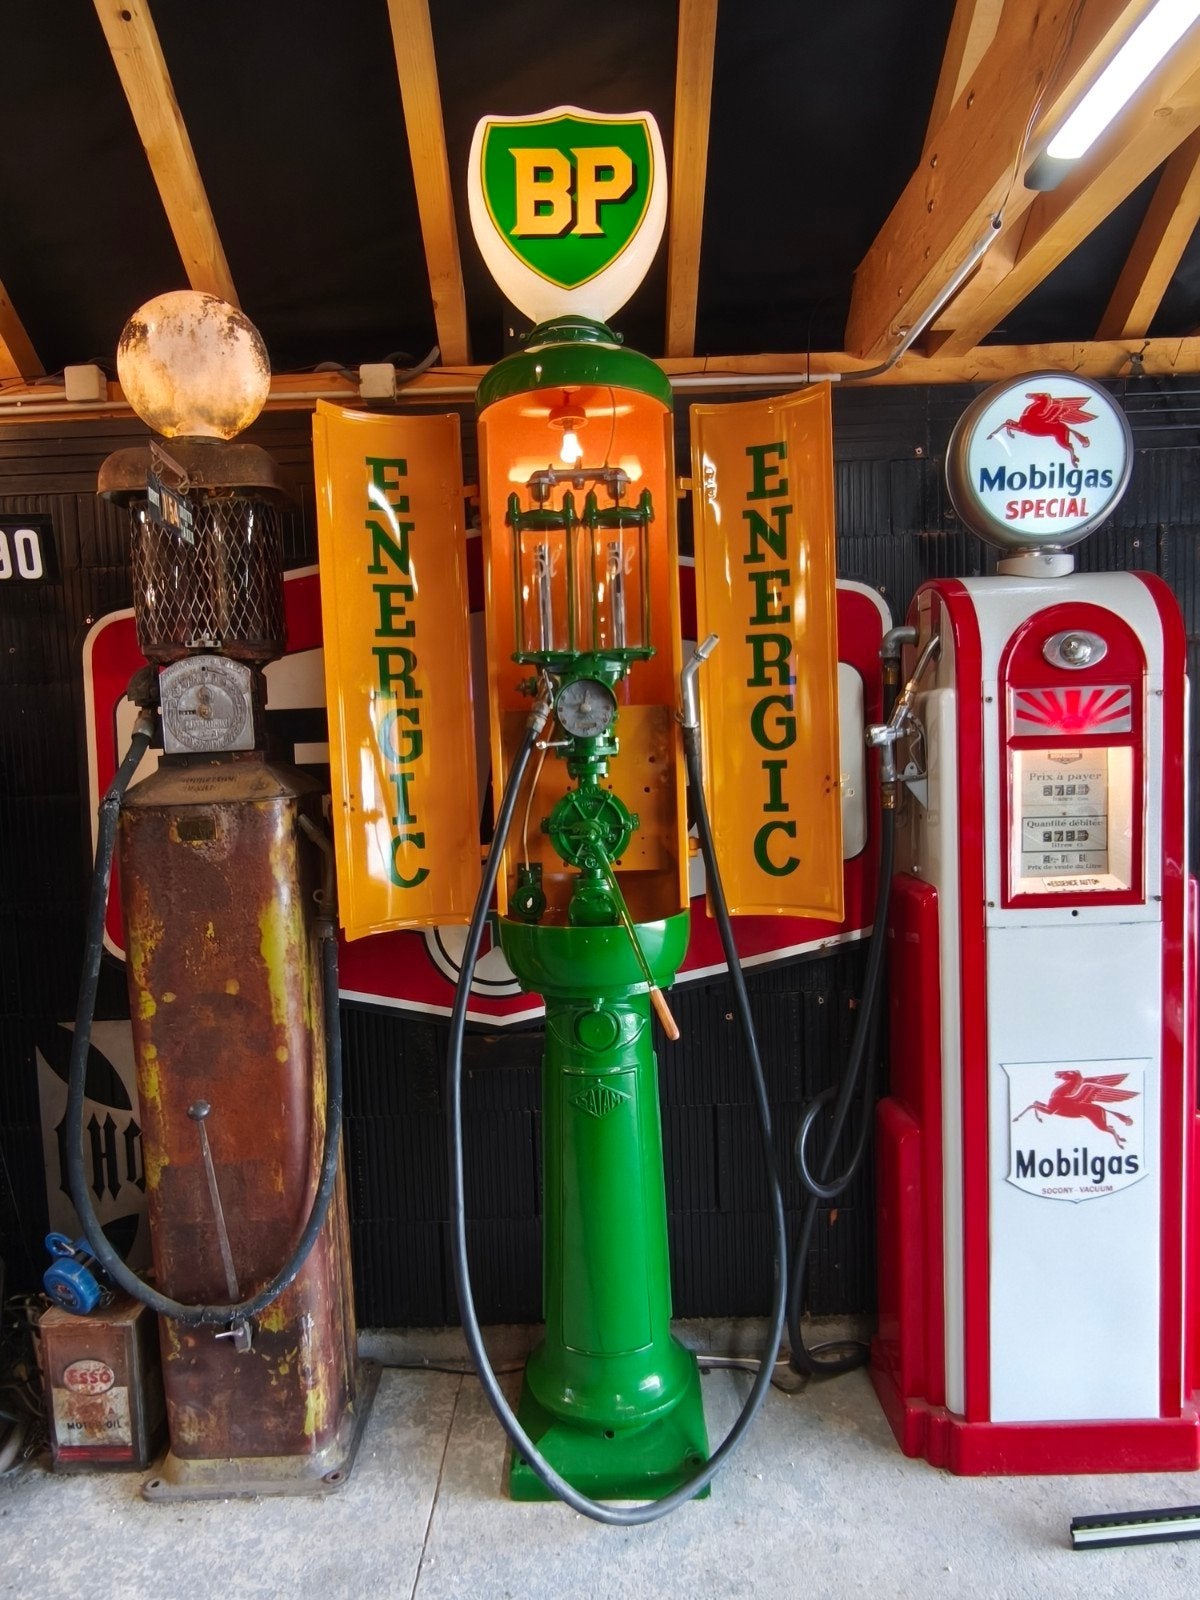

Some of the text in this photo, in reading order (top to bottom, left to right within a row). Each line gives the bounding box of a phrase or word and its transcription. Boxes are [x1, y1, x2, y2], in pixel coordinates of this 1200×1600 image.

[508, 146, 637, 239] BP
[979, 462, 1113, 496] Mobilgas
[1005, 497, 1089, 520] SPECIAL
[365, 457, 430, 888] ENERGIC
[743, 441, 800, 877] ENERGIC
[1029, 772, 1054, 781] Prix
[1067, 773, 1102, 782] payer
[1027, 819, 1067, 828] Quantité
[1016, 1147, 1139, 1184] Mobilgas
[106, 1419, 122, 1429] OIL
